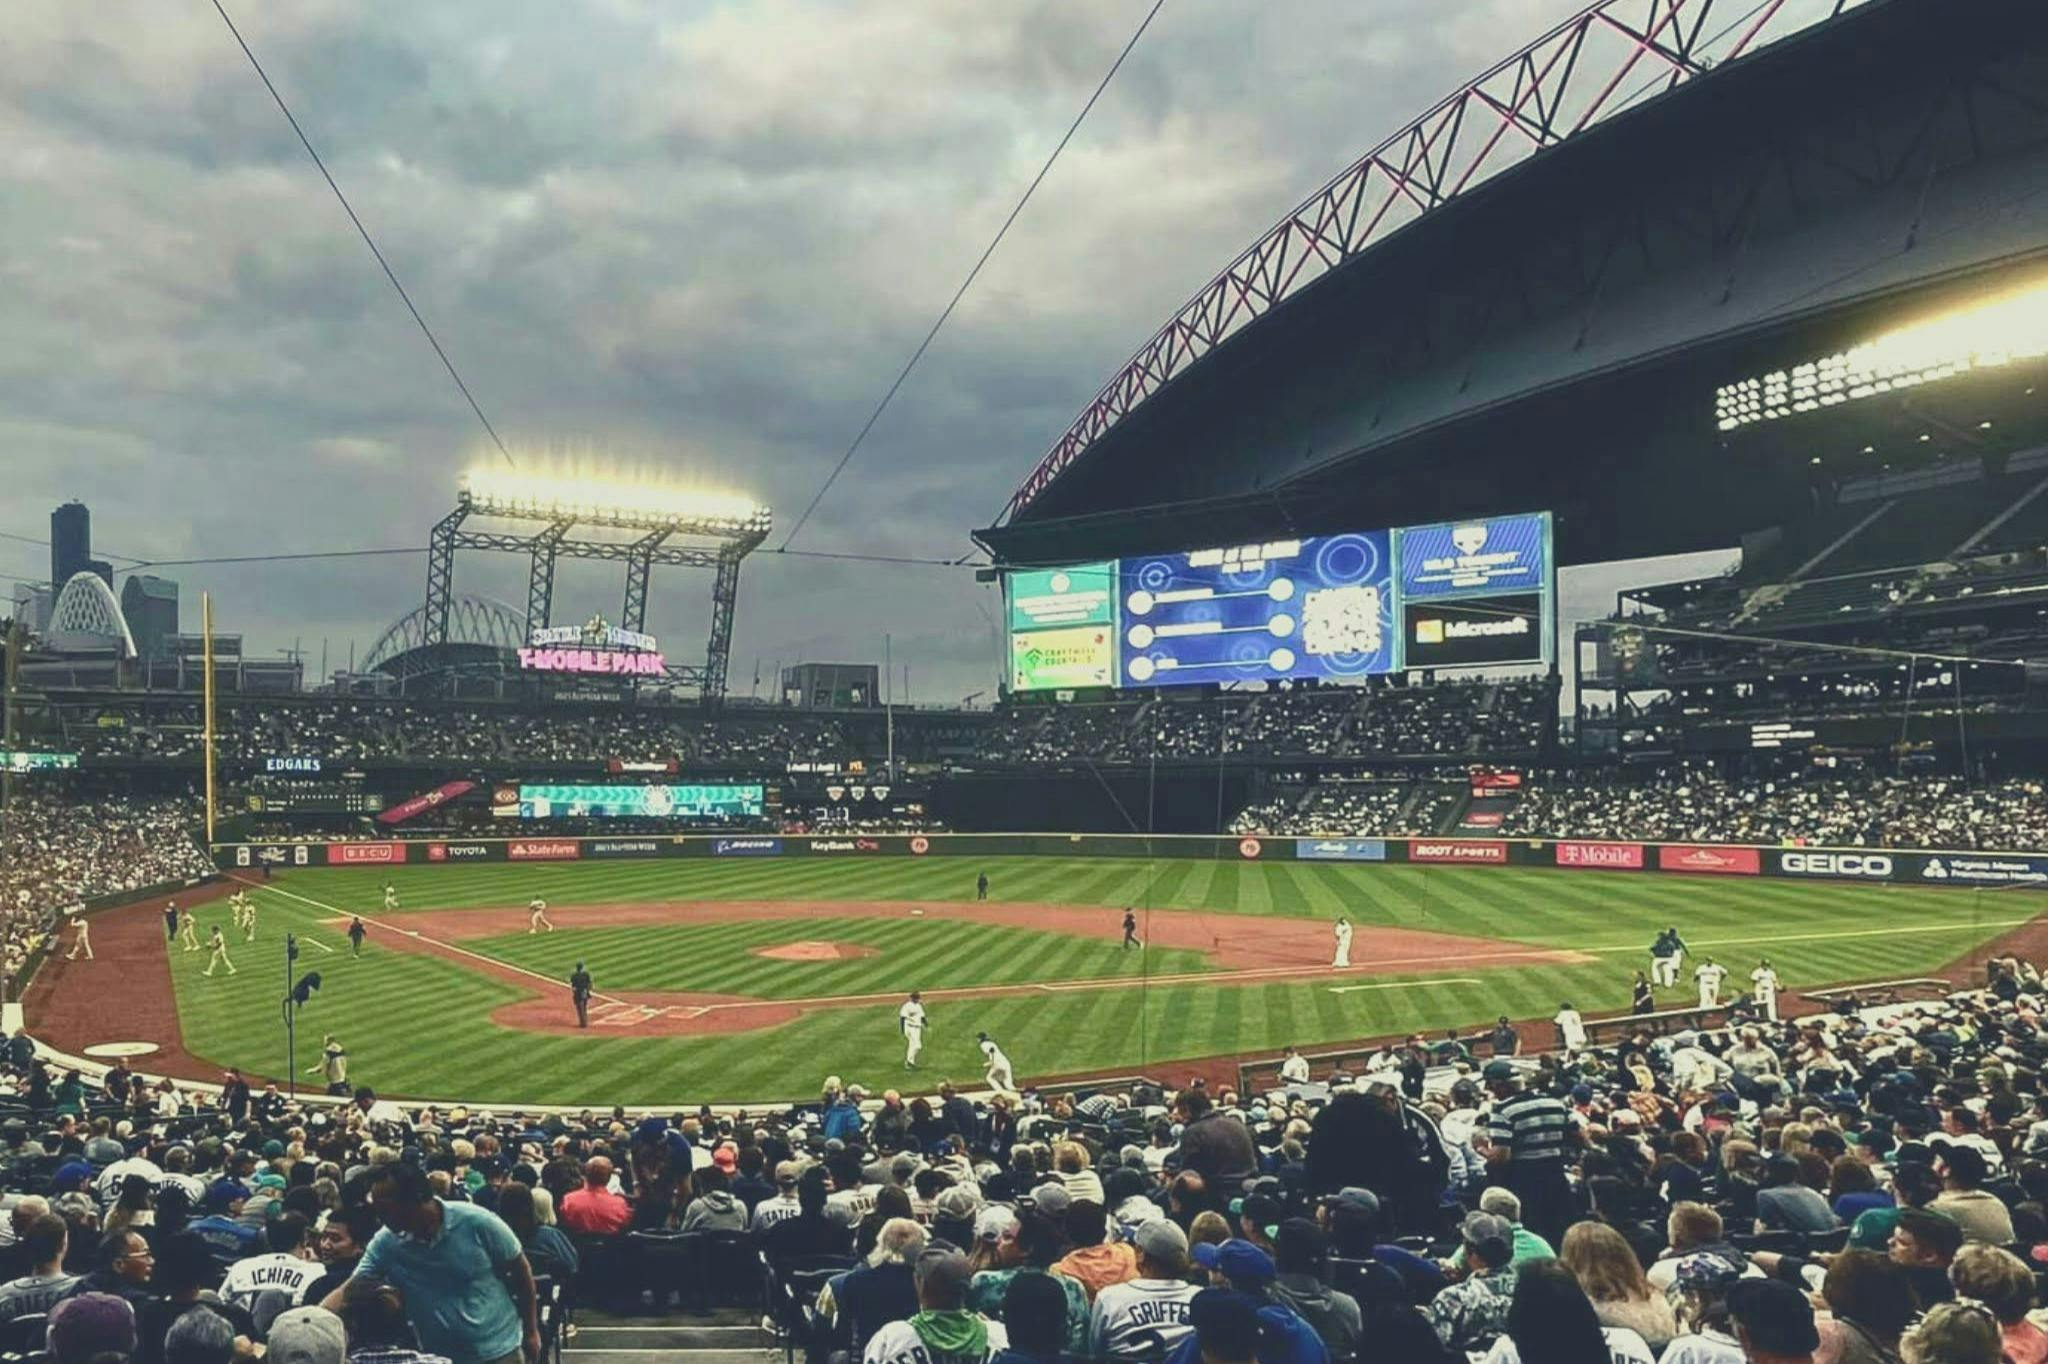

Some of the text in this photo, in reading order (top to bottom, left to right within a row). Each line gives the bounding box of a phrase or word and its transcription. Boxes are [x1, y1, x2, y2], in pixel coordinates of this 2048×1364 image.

[517, 648, 665, 674] T-MOBILE PARK
[347, 847, 388, 858] BECU
[448, 846, 487, 856] TOYOTA
[810, 840, 855, 852] KeyBank
[1416, 845, 1500, 857] ROOT SPORTS
[1580, 846, 1632, 864] Mobile
[1781, 853, 1893, 875] GEICO
[251, 1267, 304, 1289] ICHIRO
